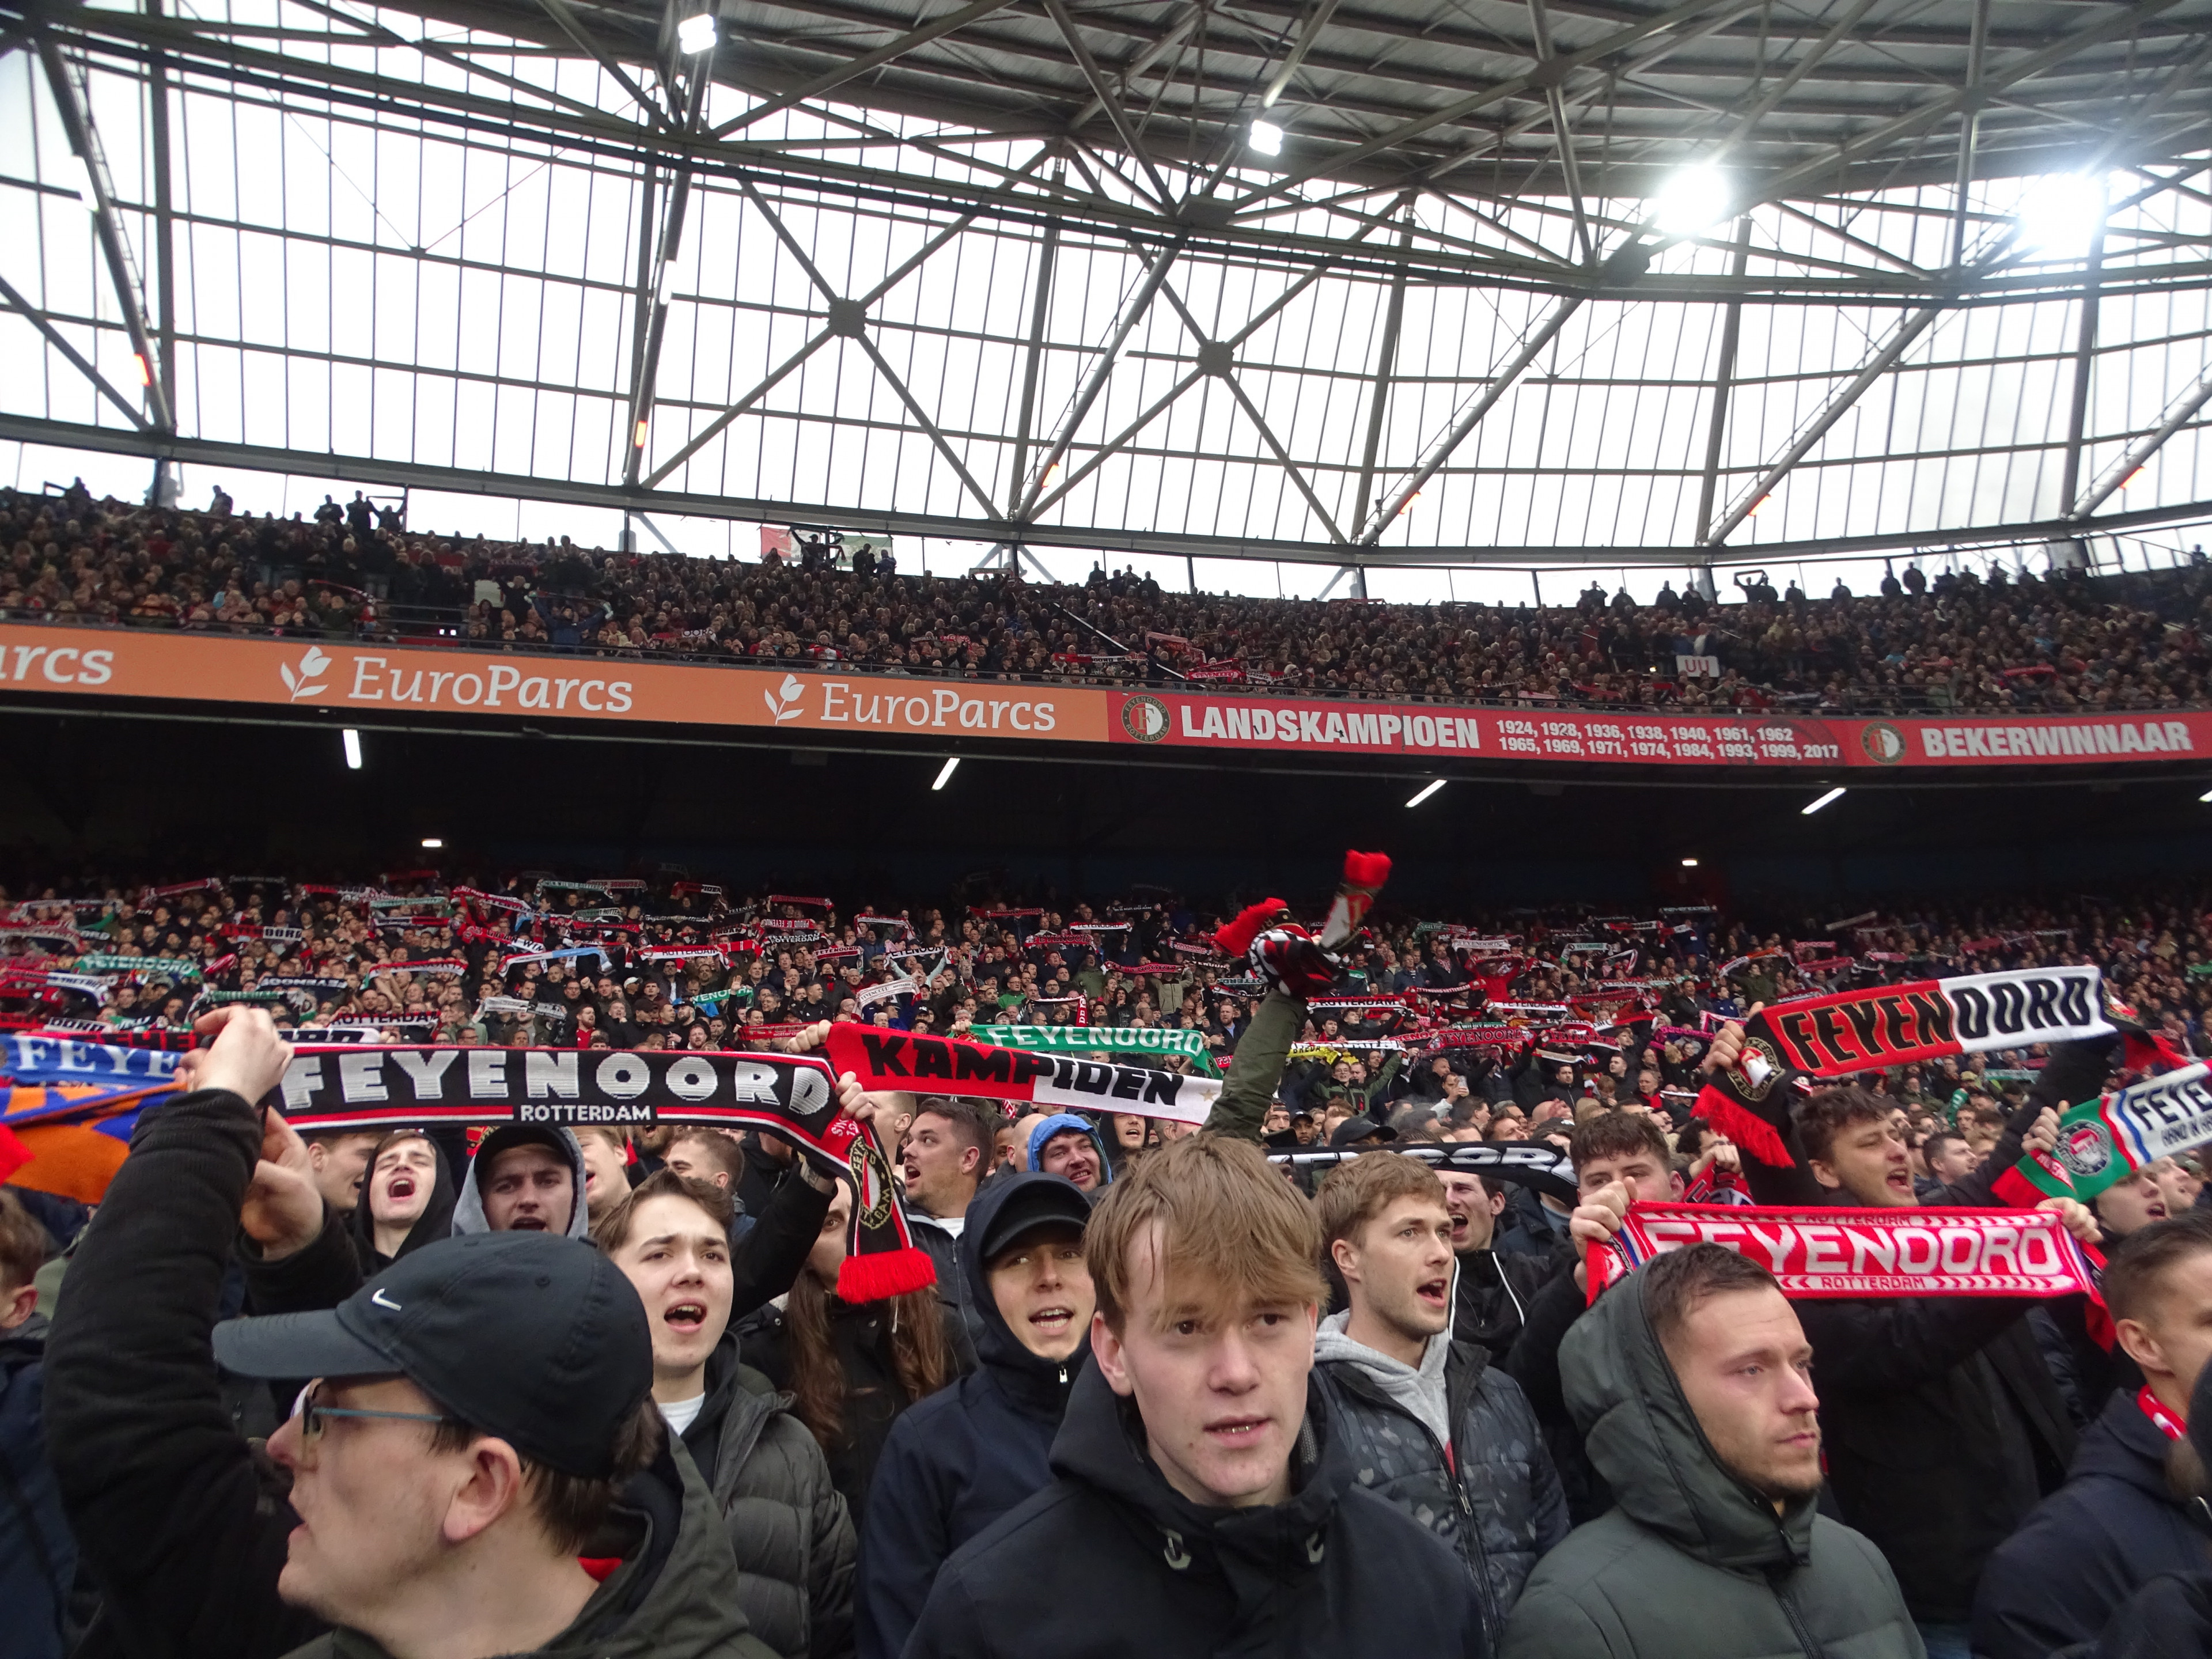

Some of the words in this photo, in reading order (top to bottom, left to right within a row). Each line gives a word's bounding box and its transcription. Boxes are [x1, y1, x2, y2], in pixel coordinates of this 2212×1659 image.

[349, 656, 633, 713] EuroParcs
[821, 682, 1056, 732] EuroParcs
[1125, 696, 1166, 714] FEYENOORD
[1126, 724, 1168, 741] ROTTERDAM
[1181, 704, 1480, 749] LANDSKAMPIOEN
[1497, 720, 1538, 737] 1924,
[1540, 722, 1582, 739] 1928,
[1584, 724, 1624, 740] 1936,
[1627, 725, 1667, 741] 1938,
[1670, 726, 1710, 743] 1940,
[1713, 727, 1754, 743] 1961,
[1756, 728, 1793, 742] 1962
[1920, 721, 2194, 757] BEKERWINNAAR
[1499, 737, 1541, 755] 1965,
[1543, 739, 1584, 756] 1969,
[1587, 740, 1628, 757] 1971,
[1630, 742, 1671, 759] 1974,
[1674, 743, 1714, 759] 1984,
[1718, 744, 1758, 759] 1993,
[1762, 744, 1801, 760] 1999,
[1804, 745, 1839, 759] 2017
[662, 948, 719, 957] ROTTERDAM
[1320, 998, 1396, 1006] ROTTERDAM
[1777, 977, 2092, 1071] FEYENOORD
[987, 1025, 1203, 1056] FEYENOORD
[279, 1050, 831, 1115] FEYENOORD
[861, 1033, 1184, 1105] KAMPIOEN
[520, 1105, 652, 1122] ROTTERDAM
[1822, 1275, 1926, 1290] ROTTERDAM
